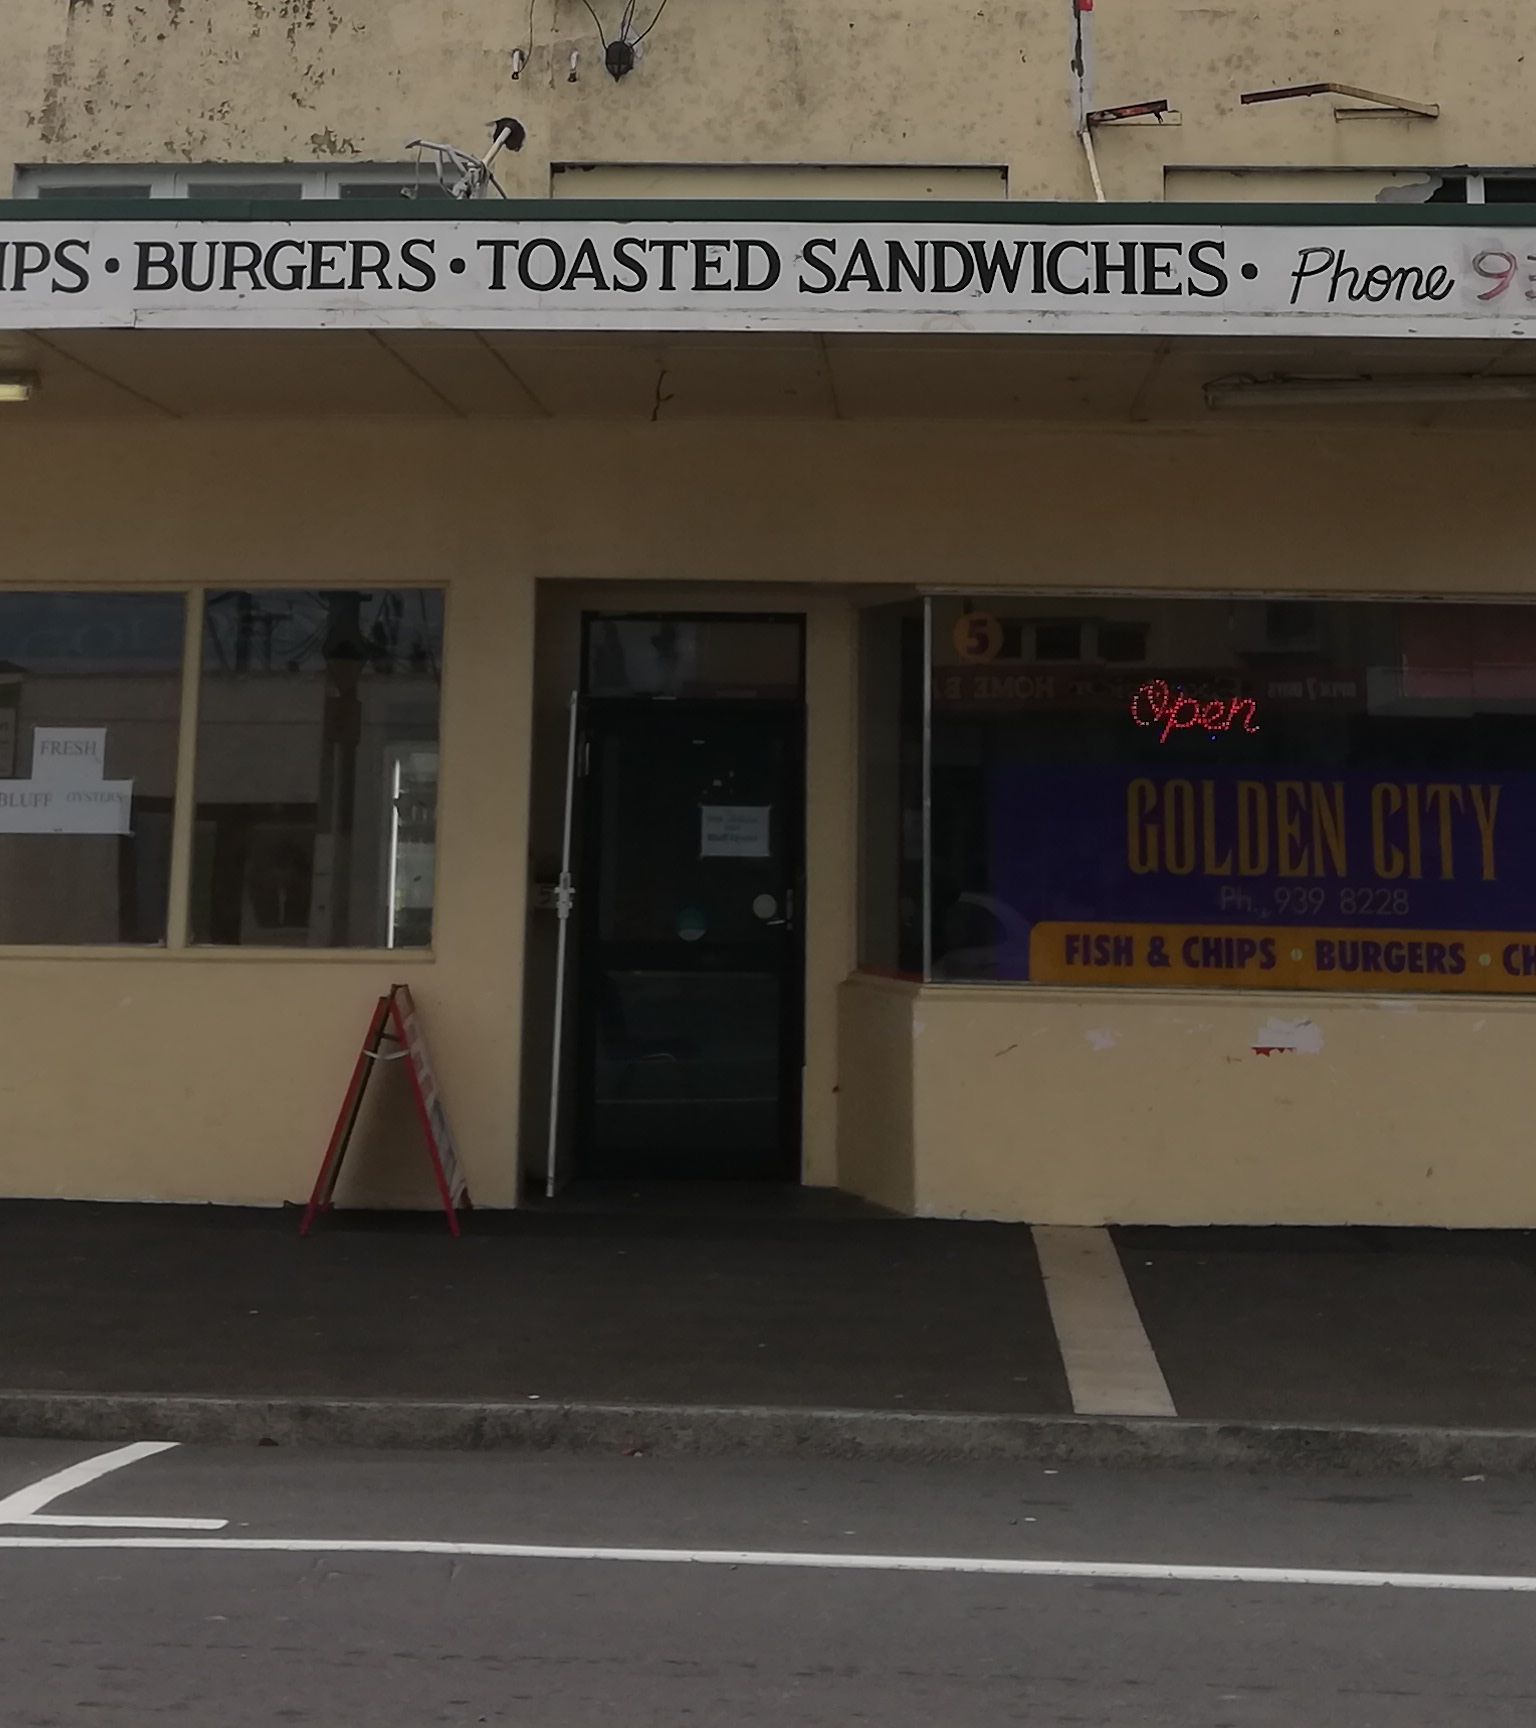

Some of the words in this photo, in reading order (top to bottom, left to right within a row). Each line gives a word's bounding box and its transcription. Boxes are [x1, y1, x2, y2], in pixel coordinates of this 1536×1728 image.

[132, 237, 437, 292] BURGERS
[477, 238, 781, 292] TOASTED
[797, 238, 1229, 296] SANDWICHES
[1290, 247, 1456, 305] Phone
[1130, 678, 1260, 744] Open
[40, 739, 97, 757] FRESH
[66, 791, 123, 804] OYSTERS
[1126, 777, 1347, 877] GOLDEN
[1370, 782, 1502, 881] CITY
[1274, 886, 1326, 916] 939
[1339, 888, 1411, 917] 8228
[1065, 934, 1135, 968] FISH
[1146, 937, 1171, 968] &
[1182, 936, 1277, 970] CHIPS
[1315, 939, 1467, 974] BURGERS
